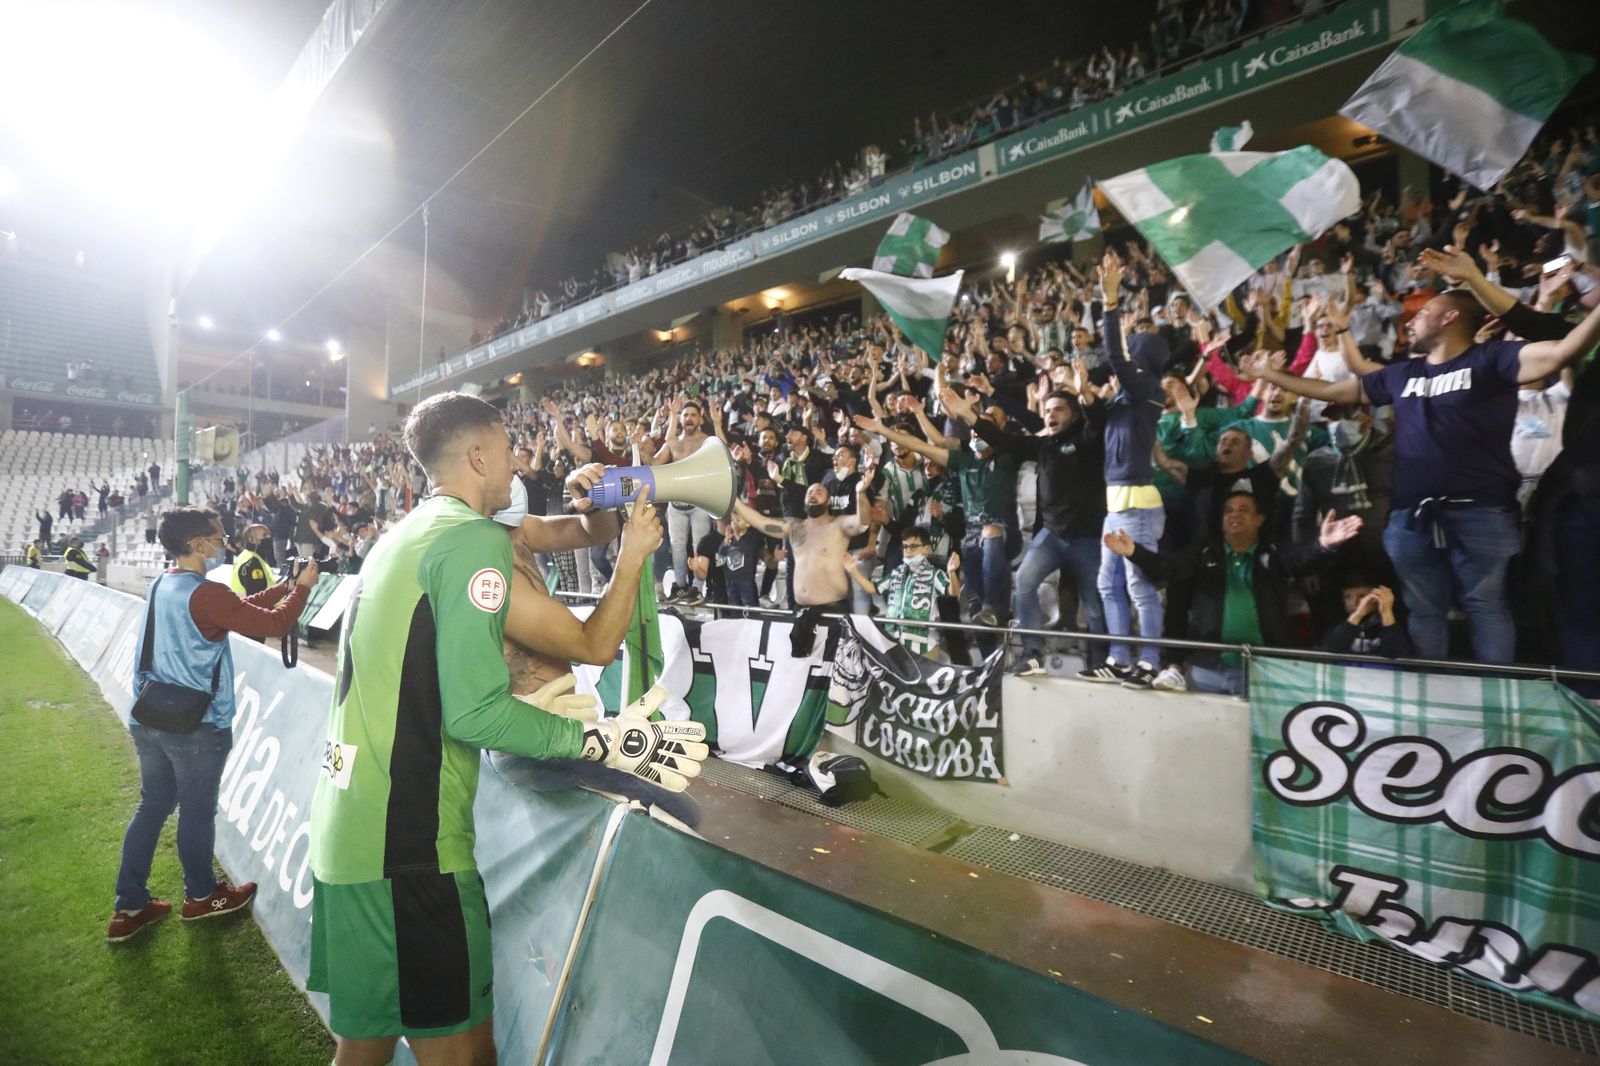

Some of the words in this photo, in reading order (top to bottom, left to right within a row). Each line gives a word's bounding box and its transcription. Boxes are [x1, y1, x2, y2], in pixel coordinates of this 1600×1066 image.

[1268, 19, 1366, 67] CaixaBank
[1135, 77, 1211, 116] CaixaBank
[1025, 121, 1089, 155] CaixaBank
[912, 161, 976, 195] SILBON
[836, 193, 890, 222] SILBON
[771, 220, 818, 247] SILBON
[879, 682, 998, 736] SCHOOL
